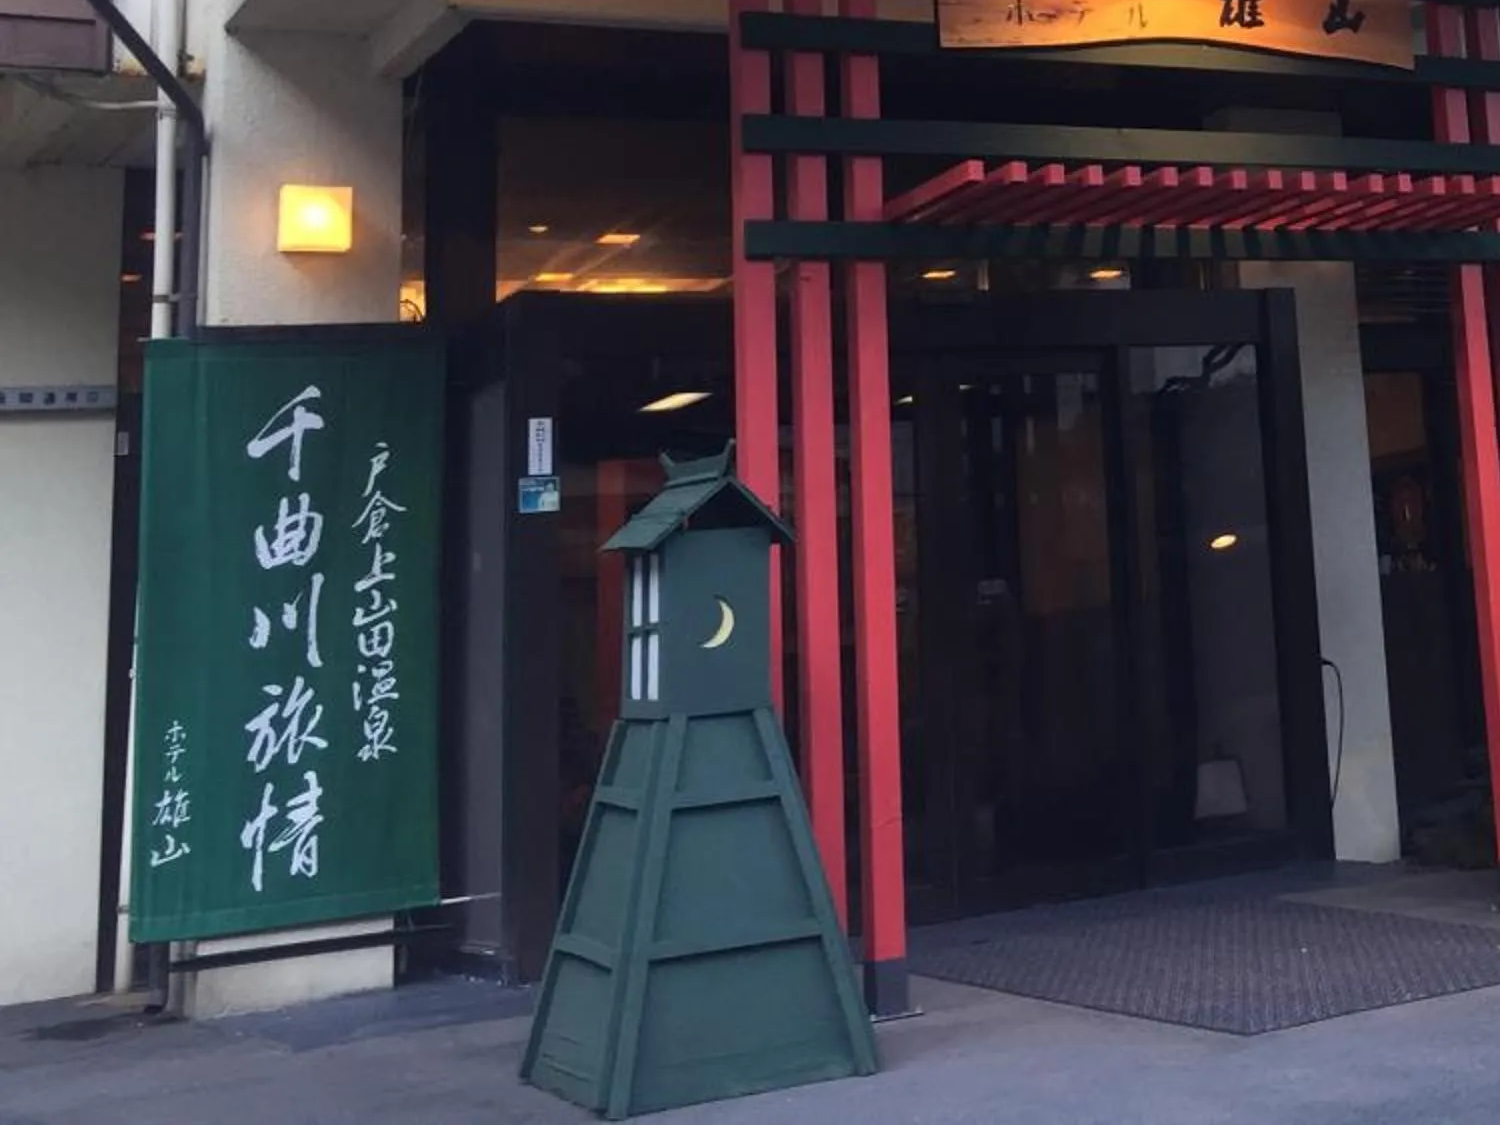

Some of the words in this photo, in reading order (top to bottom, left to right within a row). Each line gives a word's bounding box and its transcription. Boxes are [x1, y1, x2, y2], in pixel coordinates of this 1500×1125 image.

[241, 386, 328, 892] 千曲川旅情
[350, 442, 407, 762] 戸倉上山田温泉
[150, 719, 191, 869] ホテル雄山
